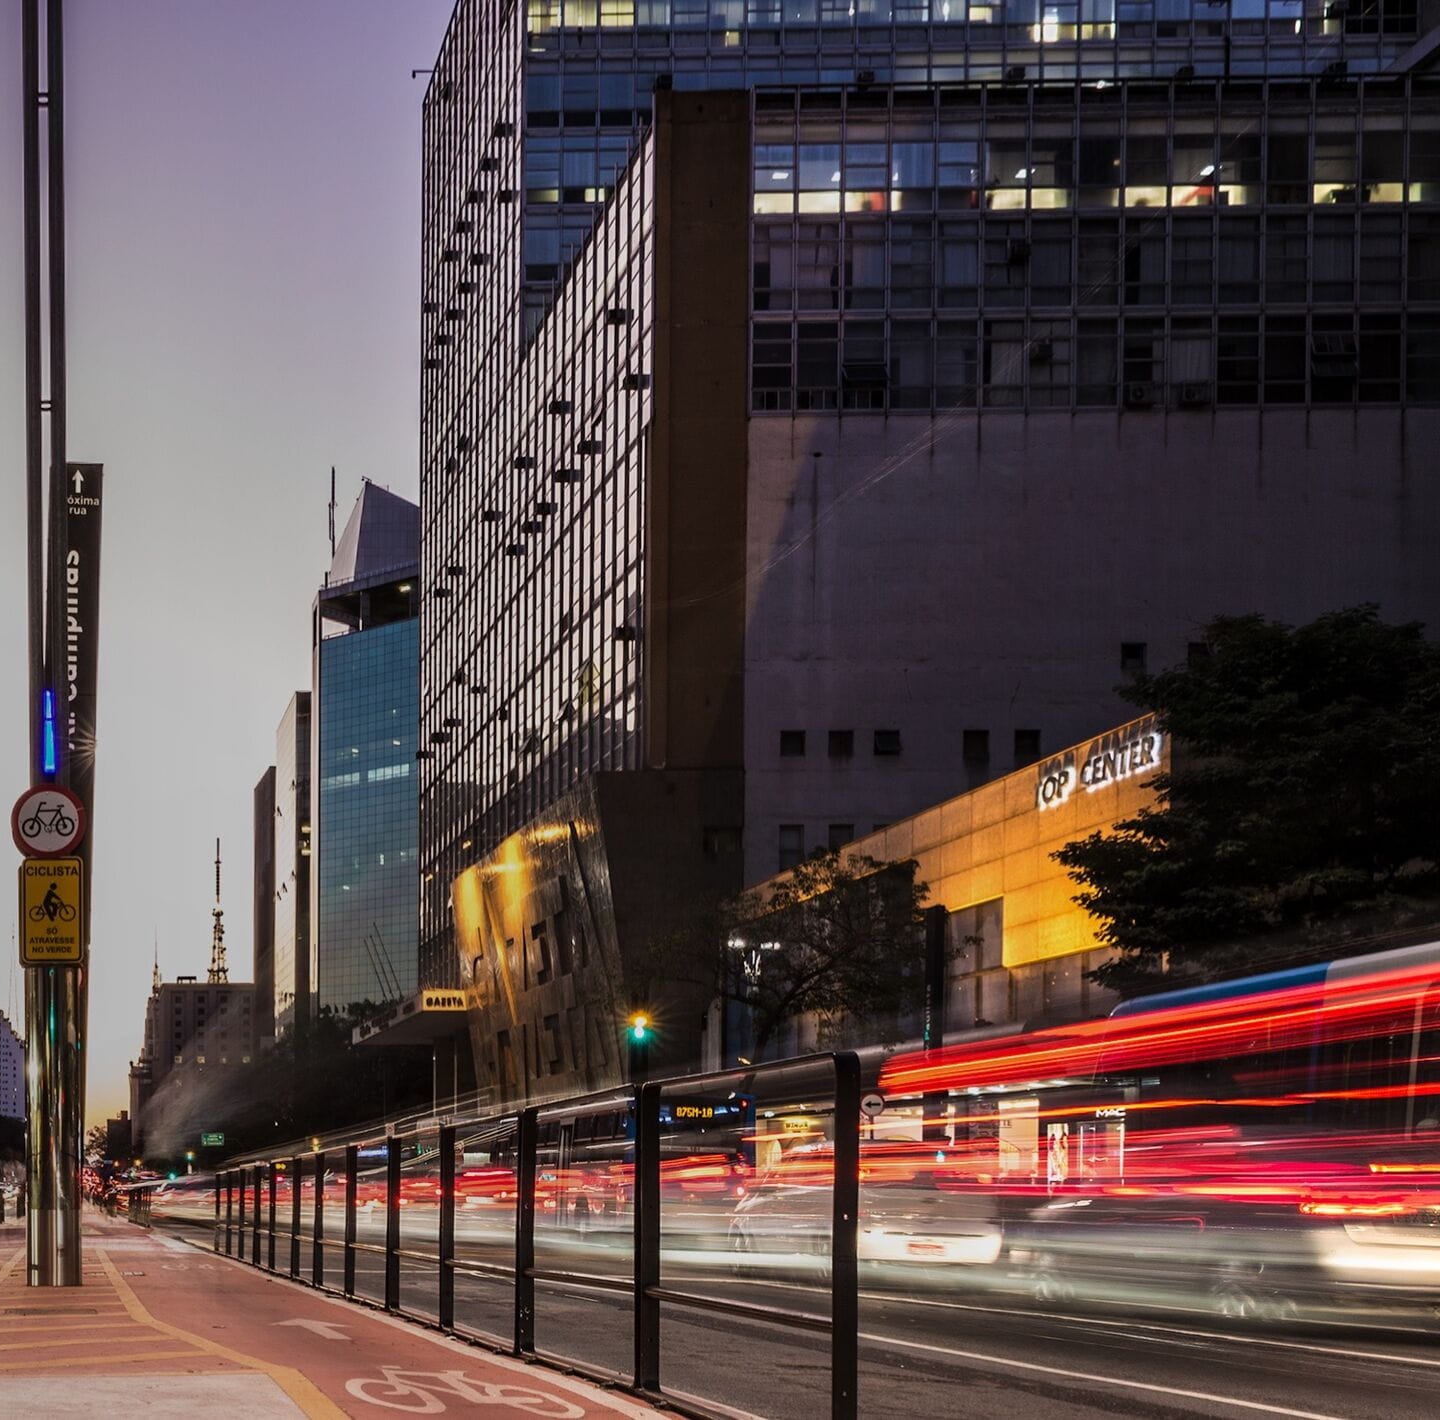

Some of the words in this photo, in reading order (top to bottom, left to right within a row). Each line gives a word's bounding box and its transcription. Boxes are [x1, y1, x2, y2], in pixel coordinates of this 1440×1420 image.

[67, 494, 100, 506] óxima
[69, 507, 87, 515] rua
[1080, 735, 1155, 785] CENTER
[26, 866, 78, 877] CICLISTA
